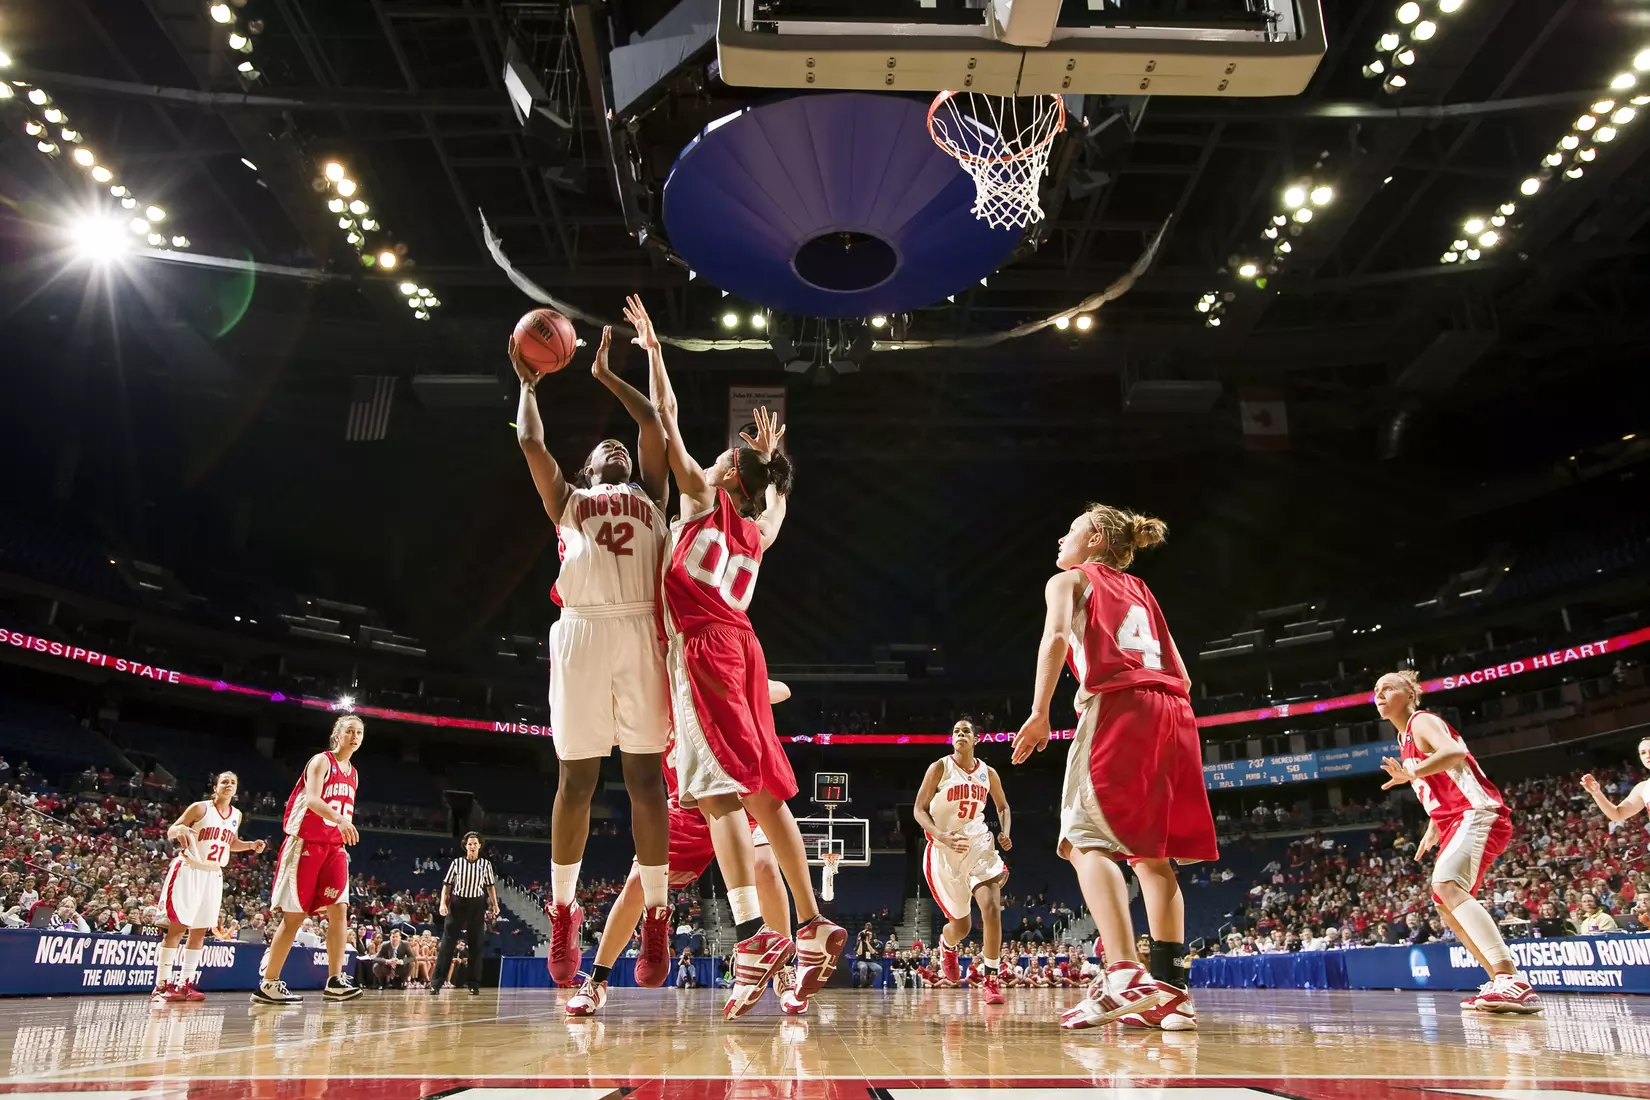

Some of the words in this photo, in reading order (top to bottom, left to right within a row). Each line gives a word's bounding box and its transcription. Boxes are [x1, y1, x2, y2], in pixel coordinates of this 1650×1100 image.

[609, 493, 653, 531] STATE
[595, 521, 634, 556] 42
[684, 527, 760, 611] 00
[1117, 604, 1161, 670] 4
[115, 658, 181, 684] STATE
[1443, 661, 1525, 690] SACRED
[1533, 640, 1609, 670] HEART
[825, 775, 845, 784] 7:37
[827, 786, 841, 800] 17
[947, 784, 969, 802] OHIO
[957, 801, 978, 820] 51
[198, 826, 221, 842] OHIO
[207, 844, 225, 863] 21
[82, 970, 101, 986] THE
[103, 970, 125, 986] OHIO
[127, 970, 155, 986] STATE
[1529, 969, 1562, 986] STATE
